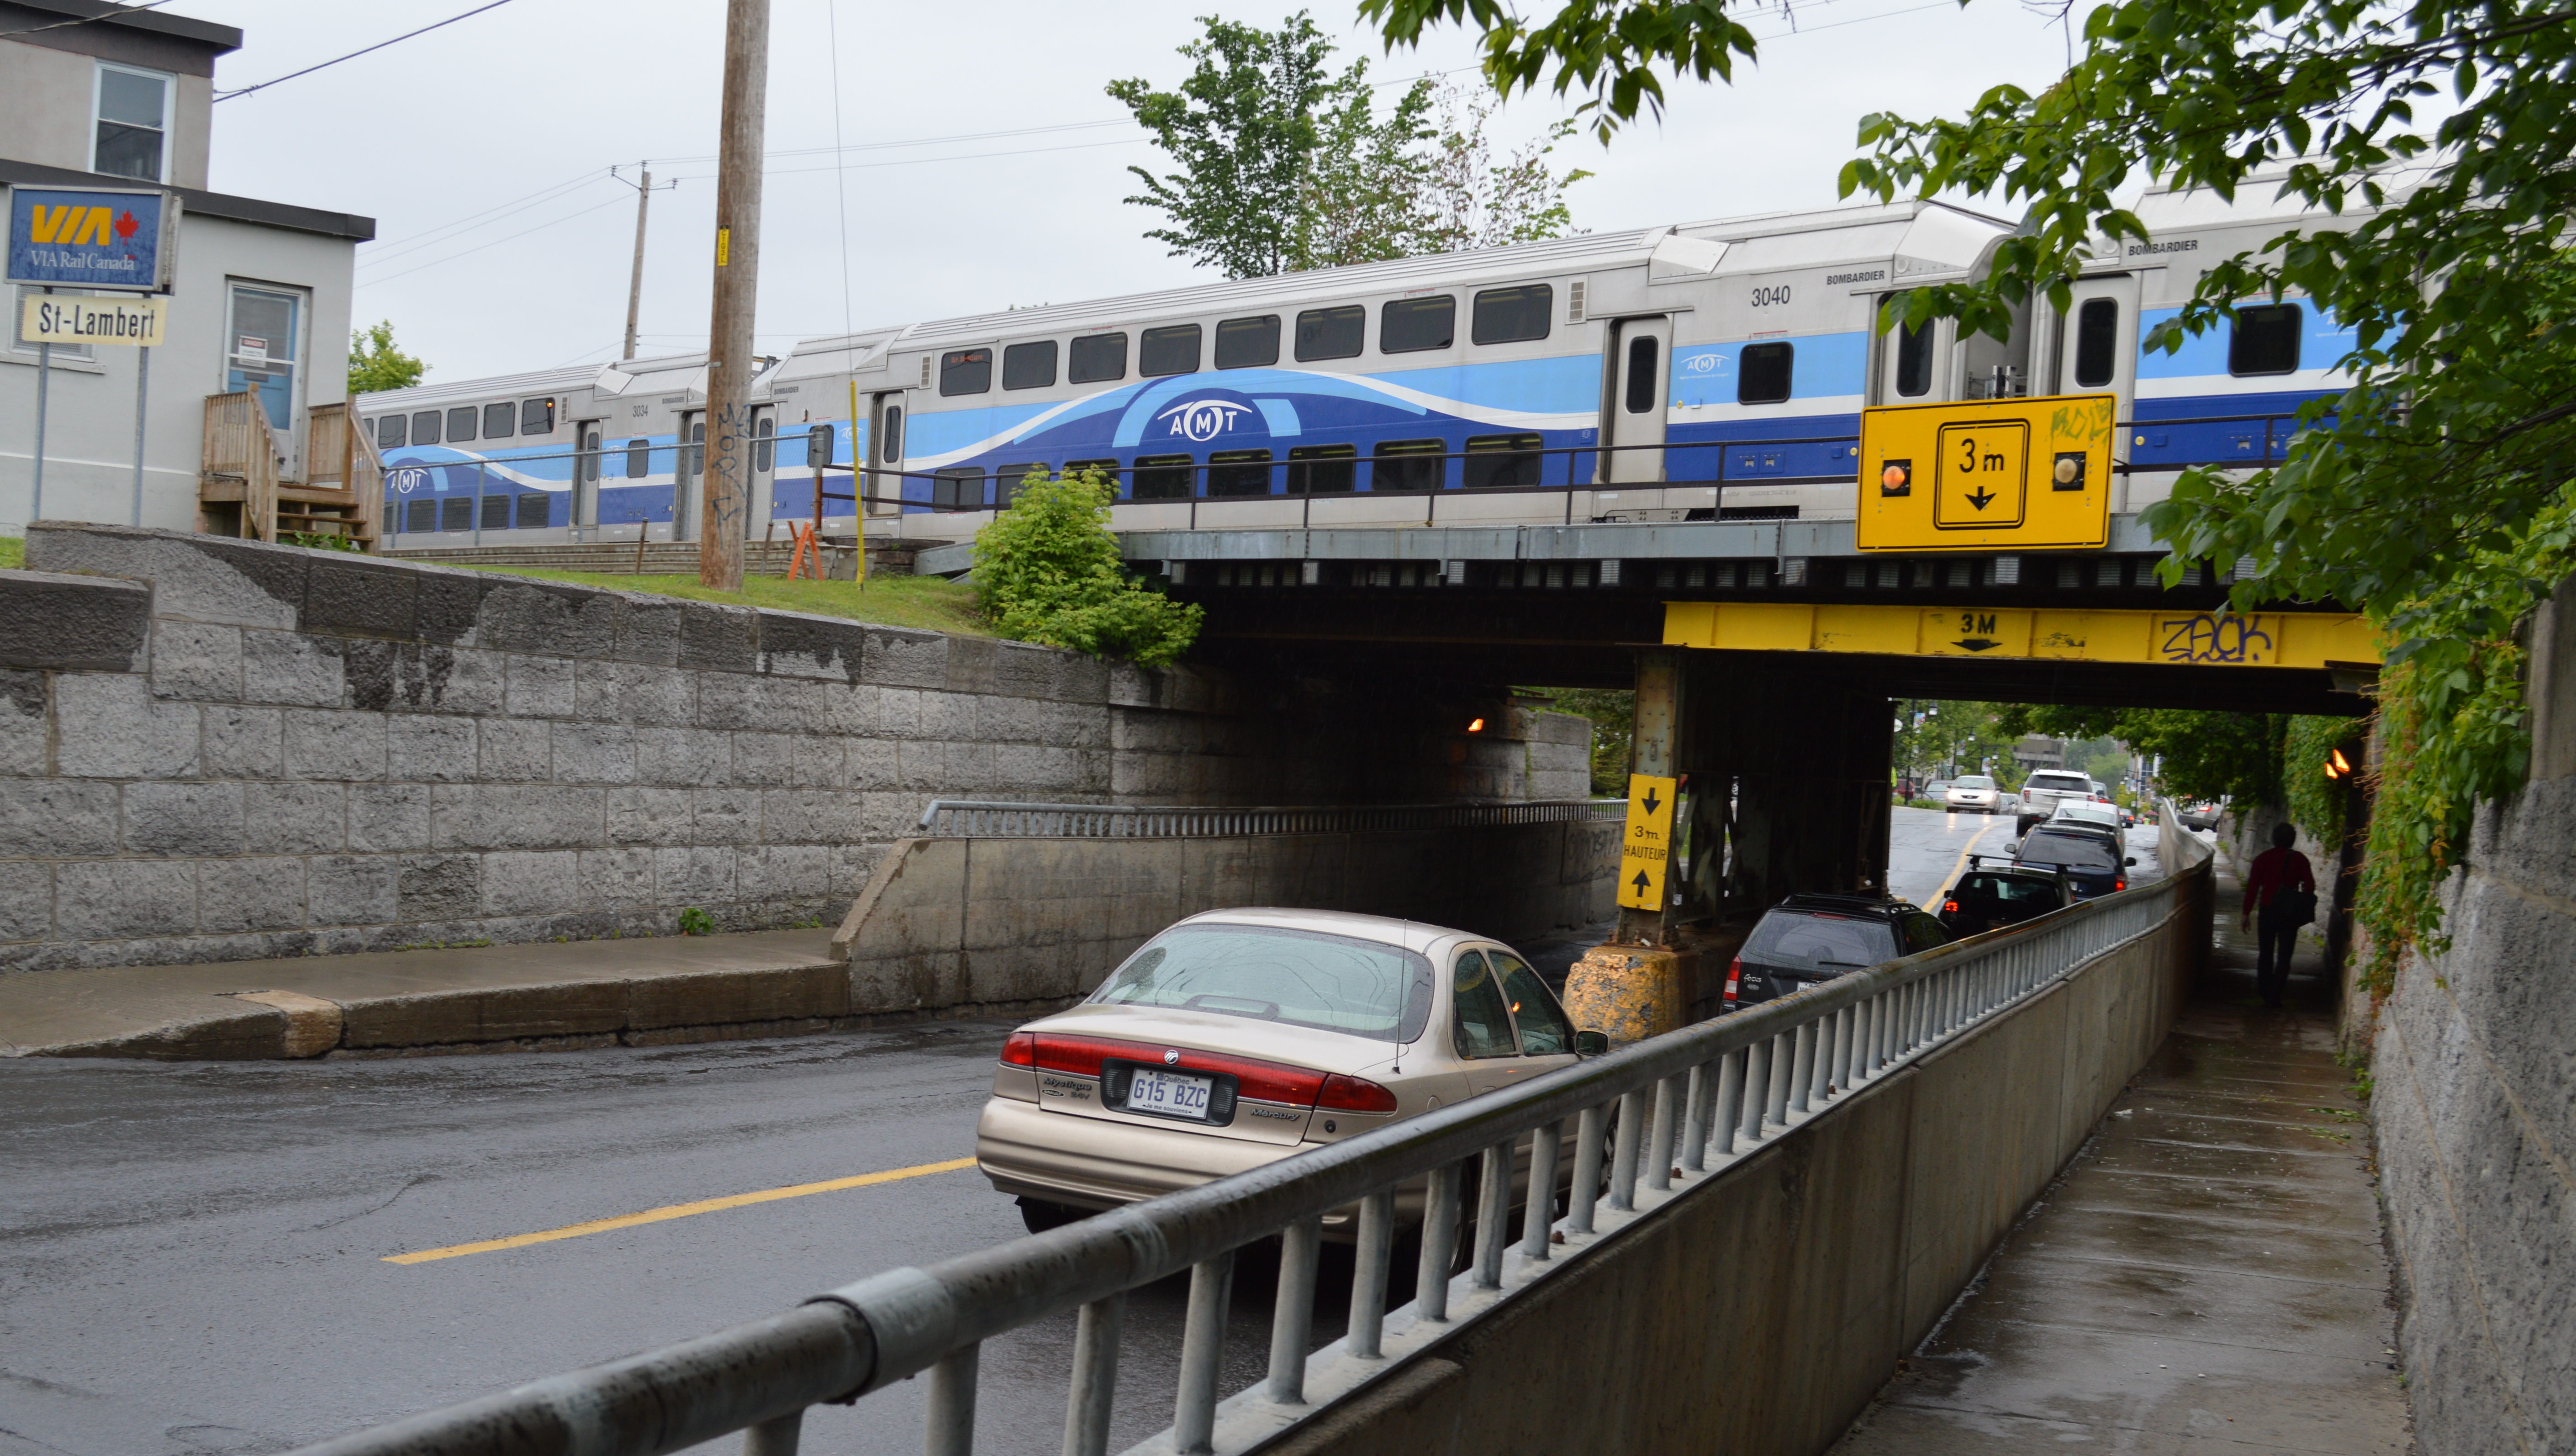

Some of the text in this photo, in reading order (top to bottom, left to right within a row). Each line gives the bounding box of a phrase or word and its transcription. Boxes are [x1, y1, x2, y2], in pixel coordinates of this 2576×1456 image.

[32, 205, 112, 245] VIA
[2128, 240, 2198, 256] BOMBARDIER
[32, 251, 135, 270] VIA Rail Canada
[1826, 270, 1884, 285] BOMBARDIER
[1752, 285, 1790, 307] 3040
[40, 302, 154, 338] St-Lambert
[1687, 359, 1722, 370] AMT
[774, 386, 799, 395] BOMBARDIER
[633, 405, 648, 417] 3034
[1170, 411, 1237, 435] AMT
[1959, 438, 2004, 473] 3 m
[1961, 614, 1996, 634] 3 M
[1635, 826, 1659, 840] 3 m
[1623, 844, 1667, 861] HAUTEUR
[1044, 1077, 1092, 1091] Mystique
[1164, 1075, 1189, 1085] Québec
[1134, 1078, 1207, 1108] G15 BZC
[1251, 1108, 1300, 1121] Mercury
